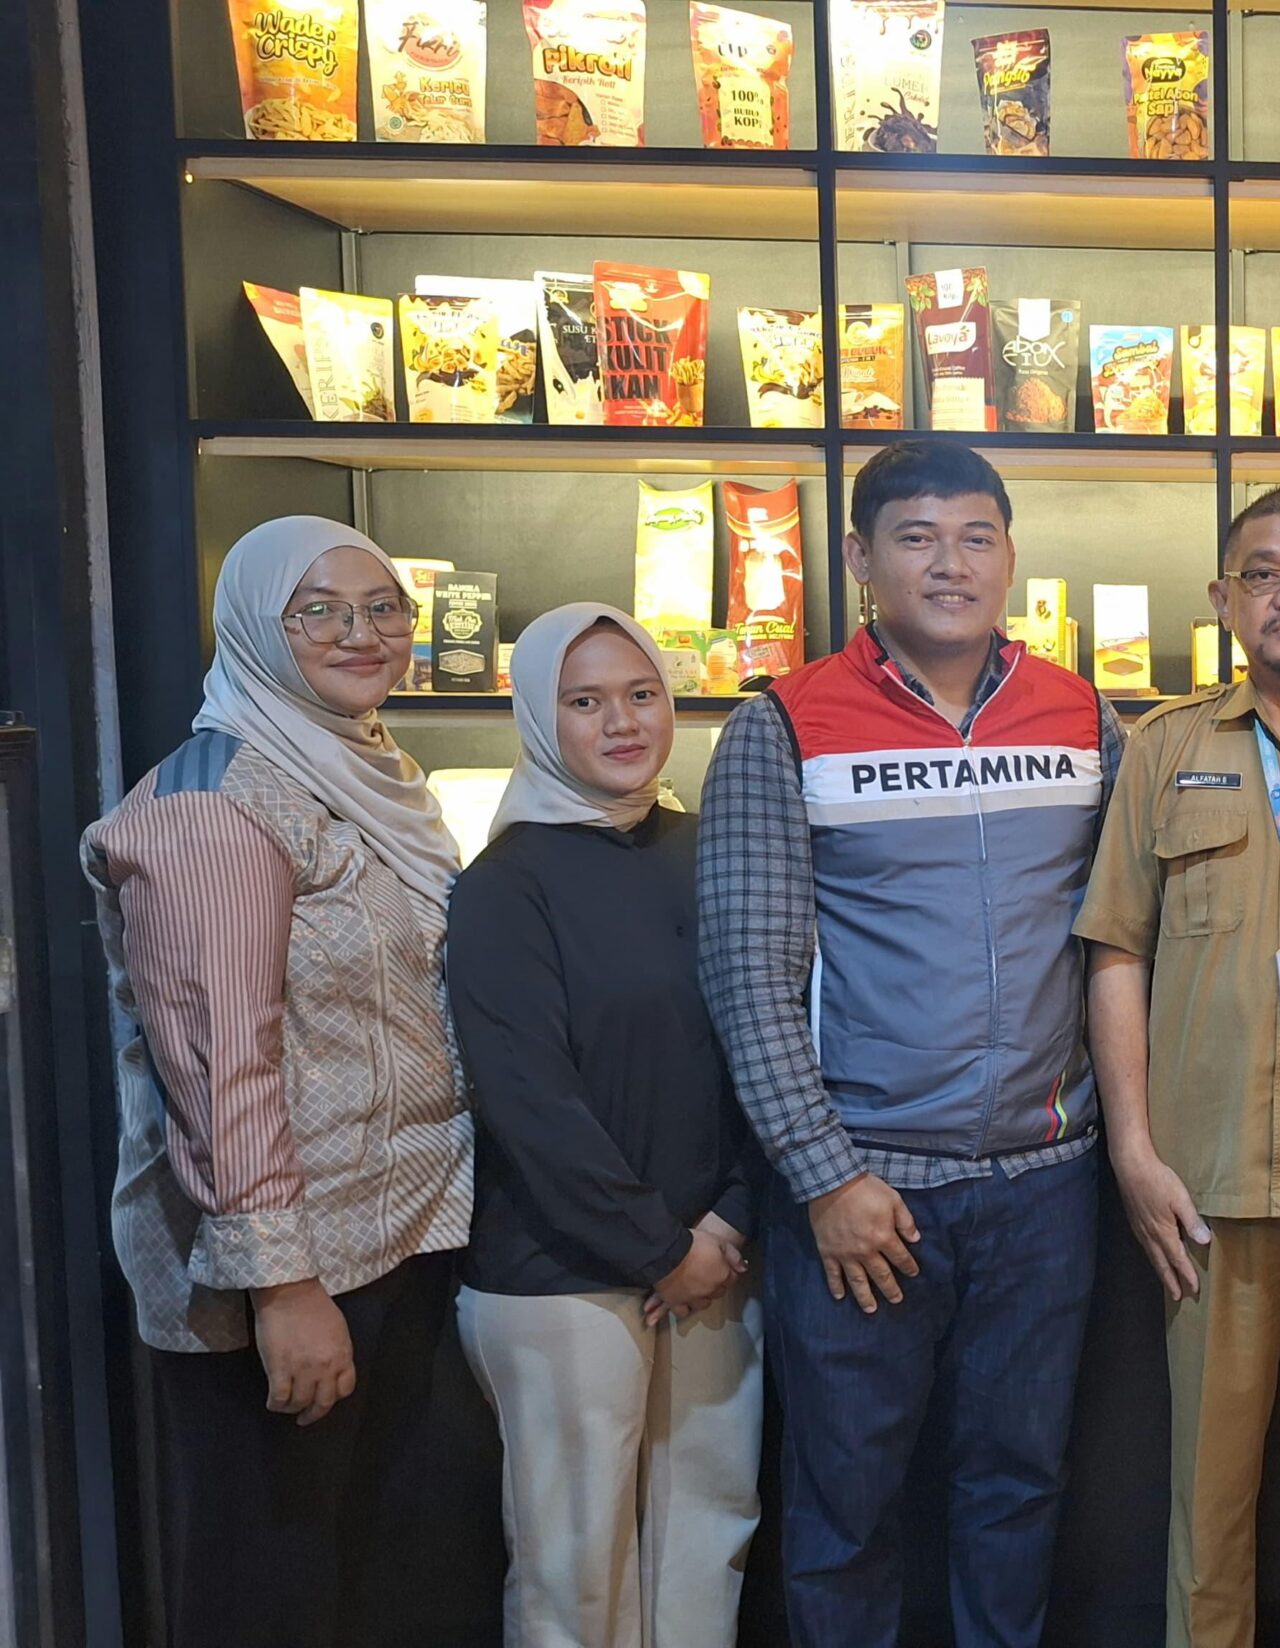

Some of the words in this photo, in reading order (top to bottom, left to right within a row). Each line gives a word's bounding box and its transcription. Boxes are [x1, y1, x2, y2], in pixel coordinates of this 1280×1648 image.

[249, 9, 336, 46] Wader
[256, 33, 338, 77] Crispy
[1165, 86, 1200, 103] Abon
[1147, 103, 1178, 118] Sap
[562, 324, 588, 334] SUSU
[603, 315, 671, 344] STICK
[604, 345, 667, 372] KULIT
[604, 374, 660, 400] IKAN
[435, 590, 461, 599] WHITE
[462, 592, 492, 600] PEPPER
[852, 754, 1077, 794] PERTAMINA
